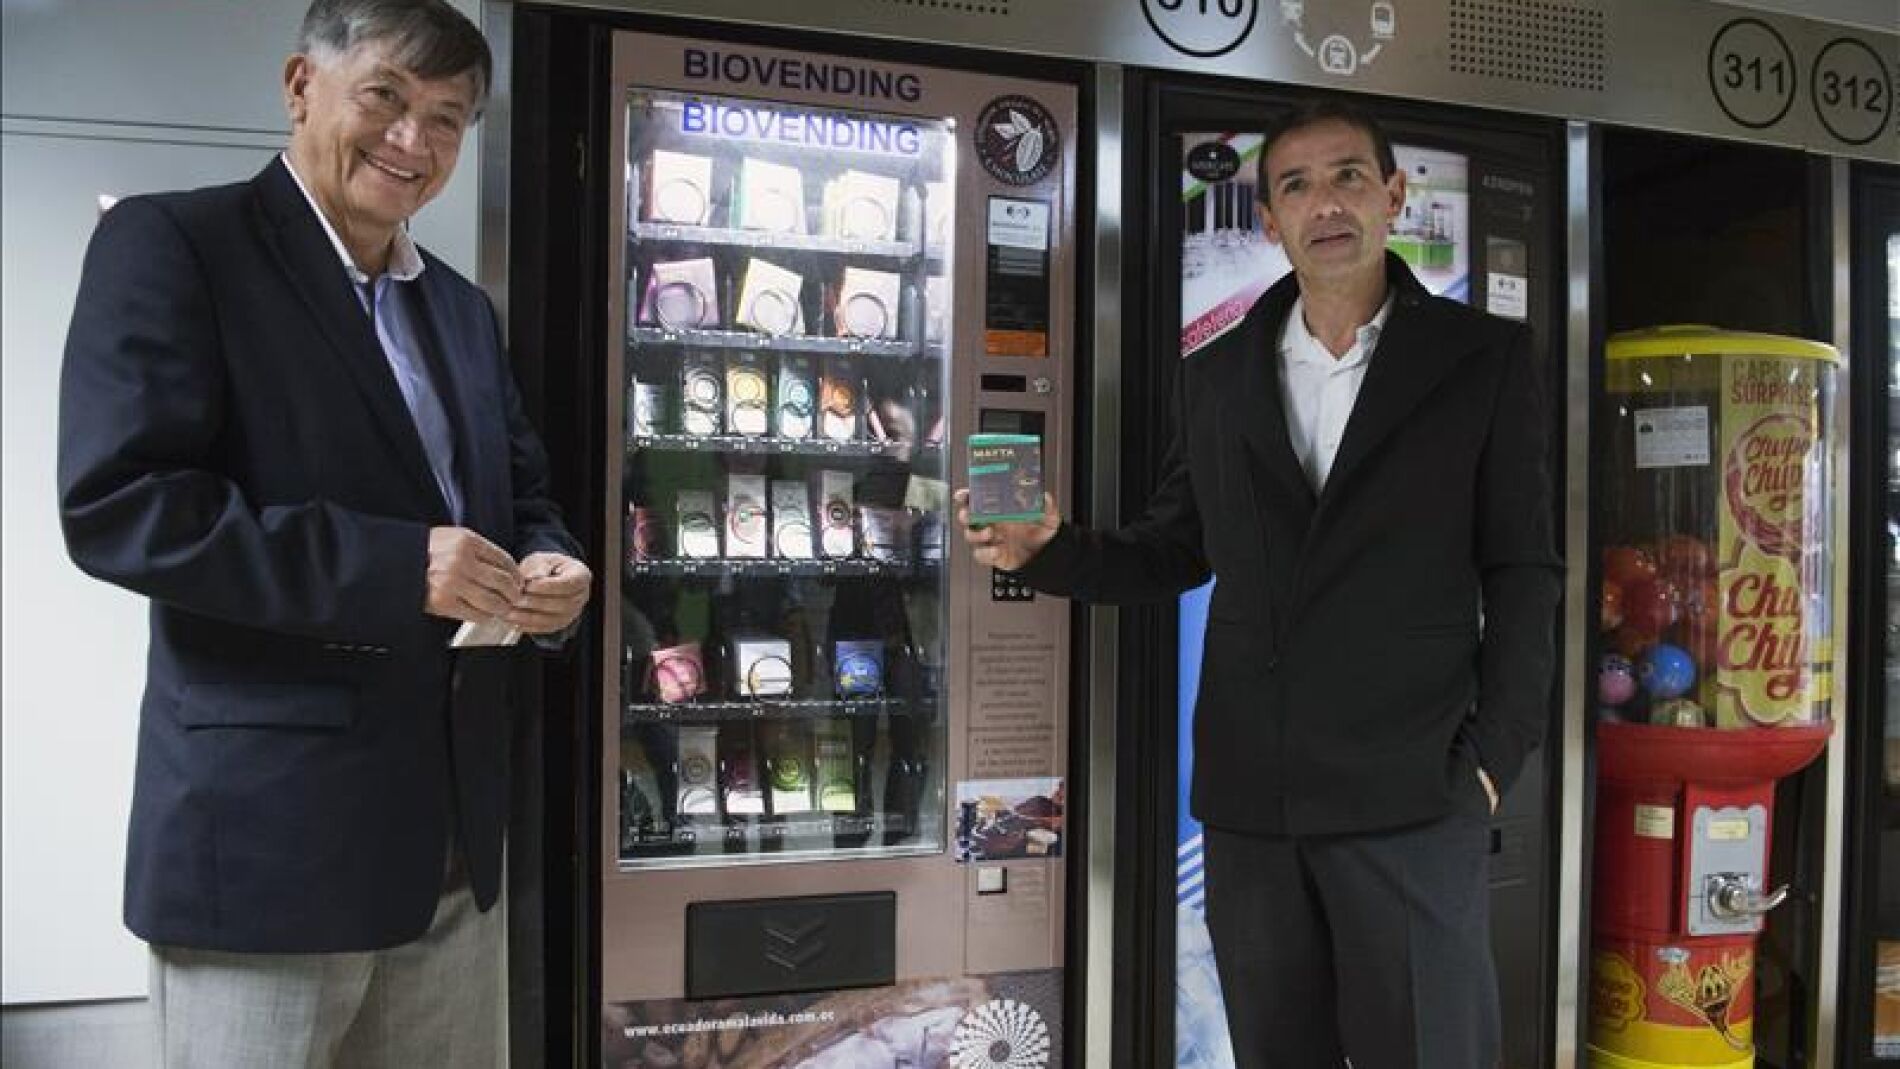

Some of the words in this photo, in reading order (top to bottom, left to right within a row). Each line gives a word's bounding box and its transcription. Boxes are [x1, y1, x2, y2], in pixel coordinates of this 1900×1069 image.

[684, 48, 920, 101] BIOVENDING
[1725, 54, 1784, 94] 311
[1823, 71, 1882, 113] 312
[684, 101, 920, 153] BIOVENDING
[1728, 575, 1801, 619] Chu
